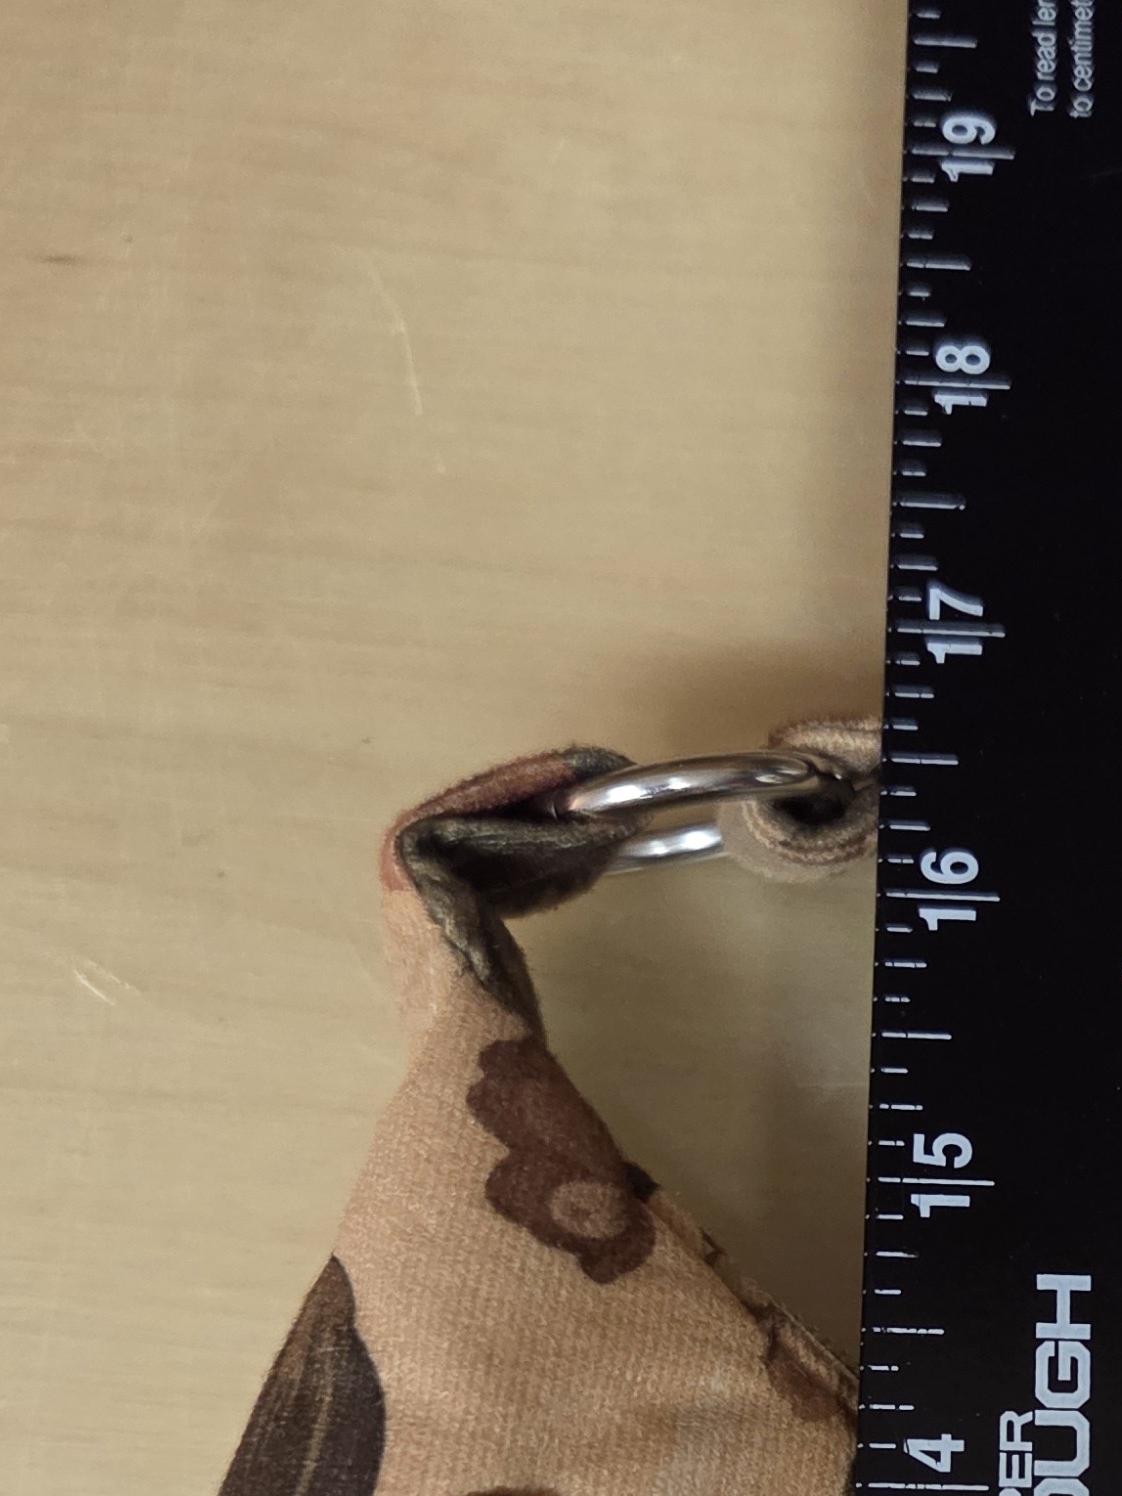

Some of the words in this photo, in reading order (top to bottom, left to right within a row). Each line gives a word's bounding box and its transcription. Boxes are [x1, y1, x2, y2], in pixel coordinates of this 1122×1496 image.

[1033, 32, 1055, 80] read
[1031, 86, 1055, 115] To
[1070, 97, 1092, 117] to
[941, 115, 996, 181] 19
[934, 343, 990, 414] 18
[927, 586, 983, 663] 17
[918, 852, 979, 930] 16
[911, 1133, 973, 1217] 15
